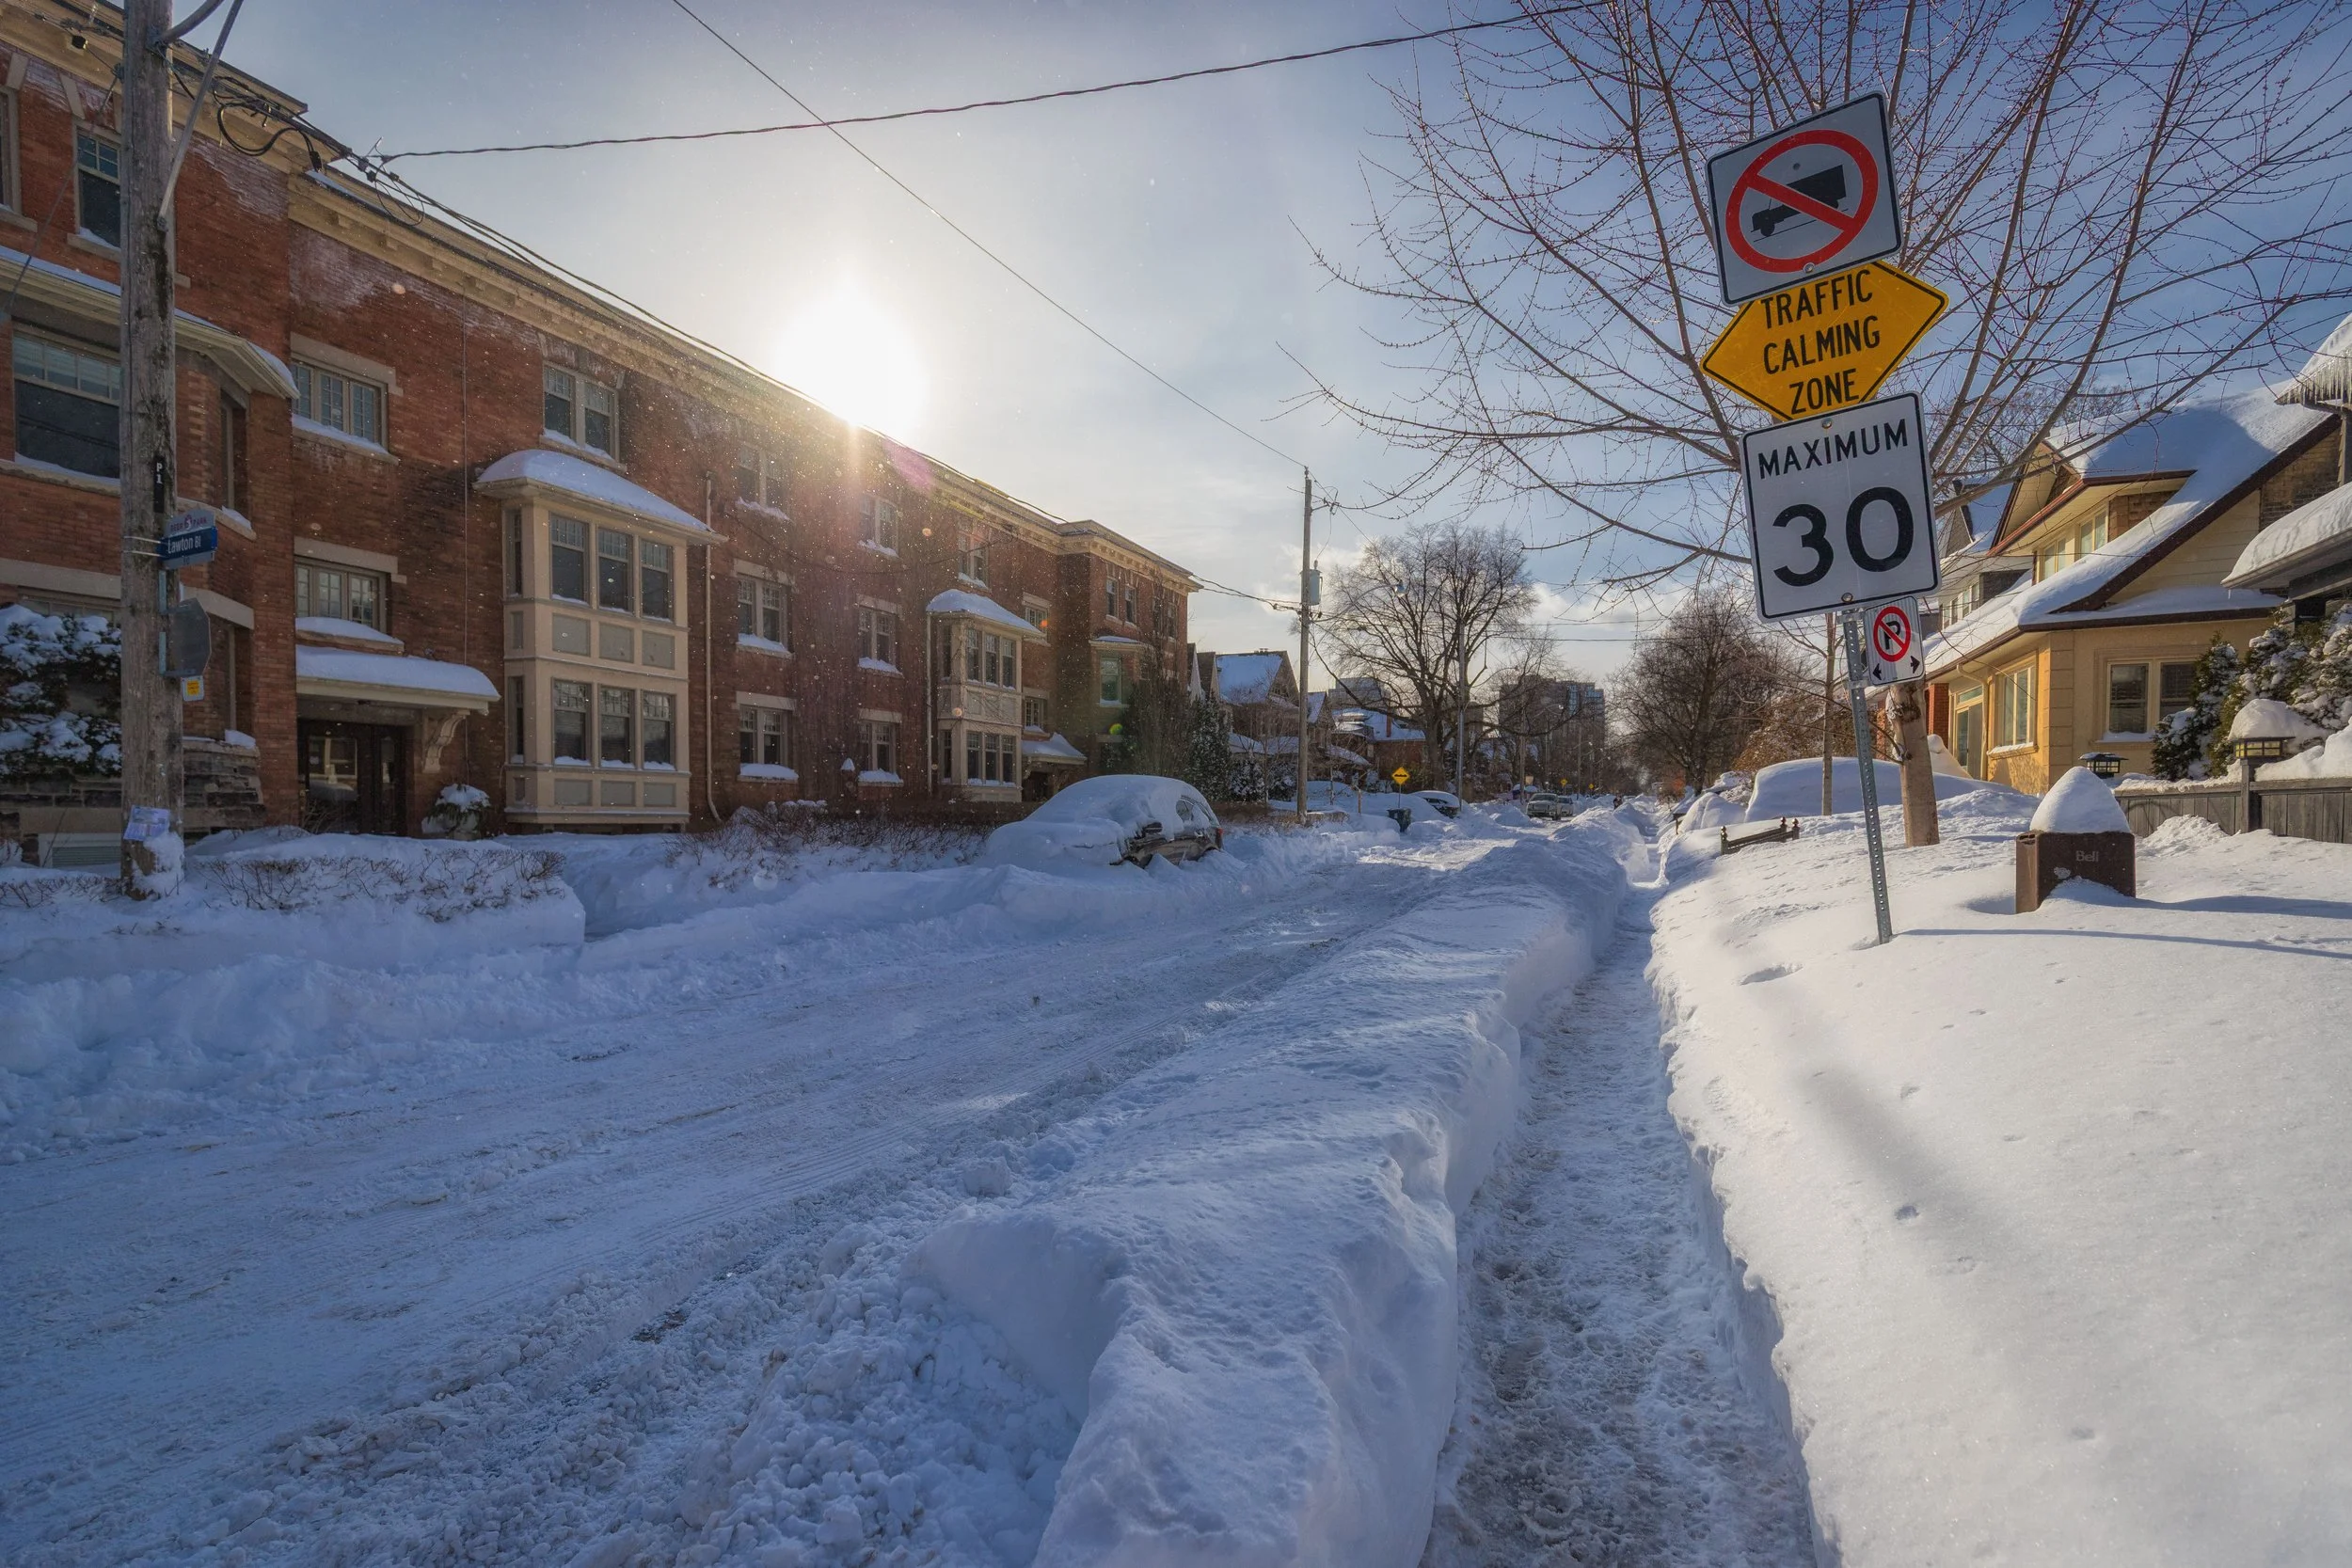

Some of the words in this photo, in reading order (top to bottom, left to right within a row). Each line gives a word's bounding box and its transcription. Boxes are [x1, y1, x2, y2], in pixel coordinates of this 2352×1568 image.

[1761, 270, 1873, 329] TRAFFIC
[1763, 316, 1881, 374] CALMING
[1789, 369, 1859, 416] ZONE
[1757, 419, 1908, 480] MAXIMUM
[167, 536, 194, 554] Lawton
[195, 535, 201, 547] Bl
[1772, 486, 1914, 587] 30
[2075, 850, 2099, 862] Bell
